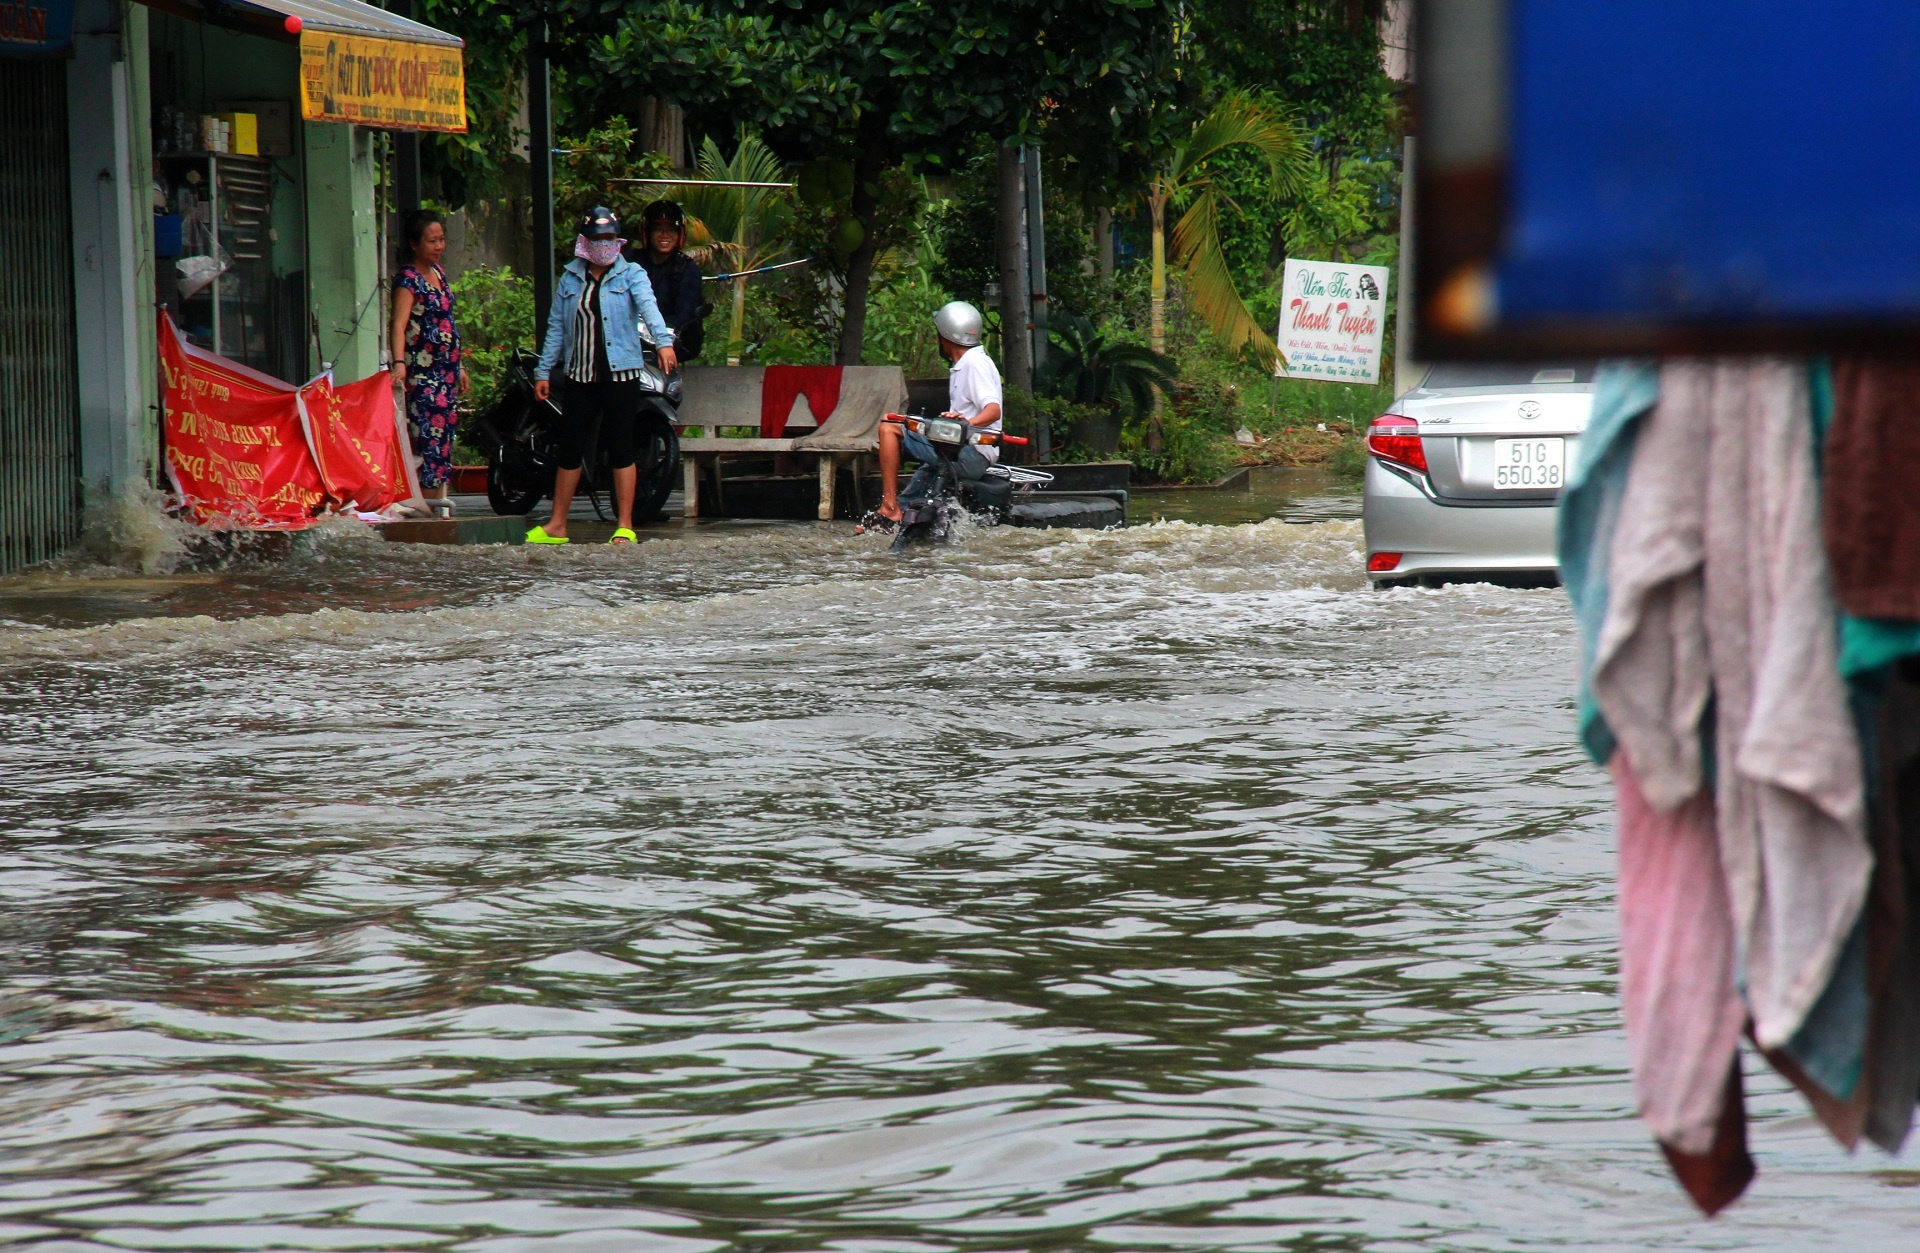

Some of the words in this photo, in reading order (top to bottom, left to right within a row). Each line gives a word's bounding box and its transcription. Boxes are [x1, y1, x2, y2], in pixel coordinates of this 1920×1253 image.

[1296, 268, 1326, 298] Uốn
[1328, 271, 1353, 299] Tóc
[1290, 298, 1333, 332] Thanh
[1336, 301, 1377, 342] Tuyền
[231, 424, 262, 454] TIẾP
[1511, 443, 1547, 464] 51G
[1497, 464, 1560, 485] 550.38
